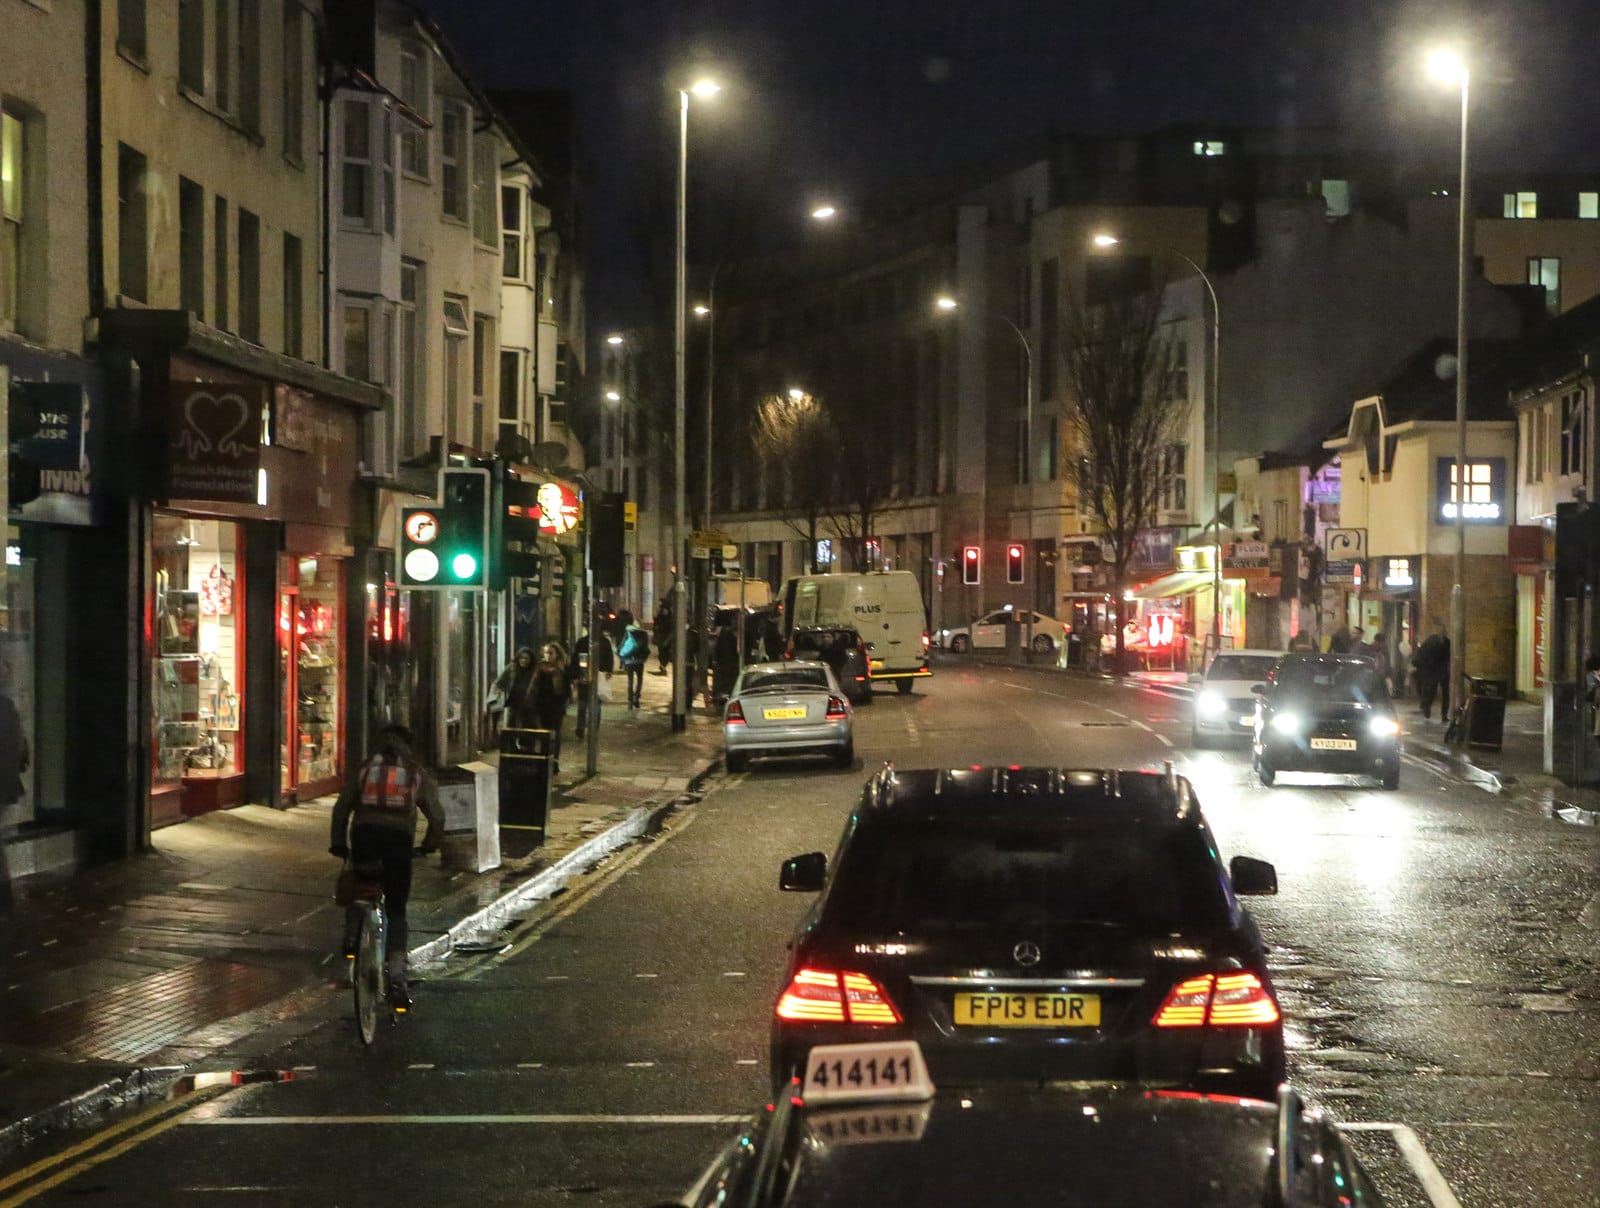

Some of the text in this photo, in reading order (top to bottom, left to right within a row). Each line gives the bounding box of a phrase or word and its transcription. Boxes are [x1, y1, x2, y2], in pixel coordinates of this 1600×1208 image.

[854, 605, 881, 614] PLUS
[970, 996, 1084, 1019] FP13 EDR
[812, 1055, 912, 1087] 414141
